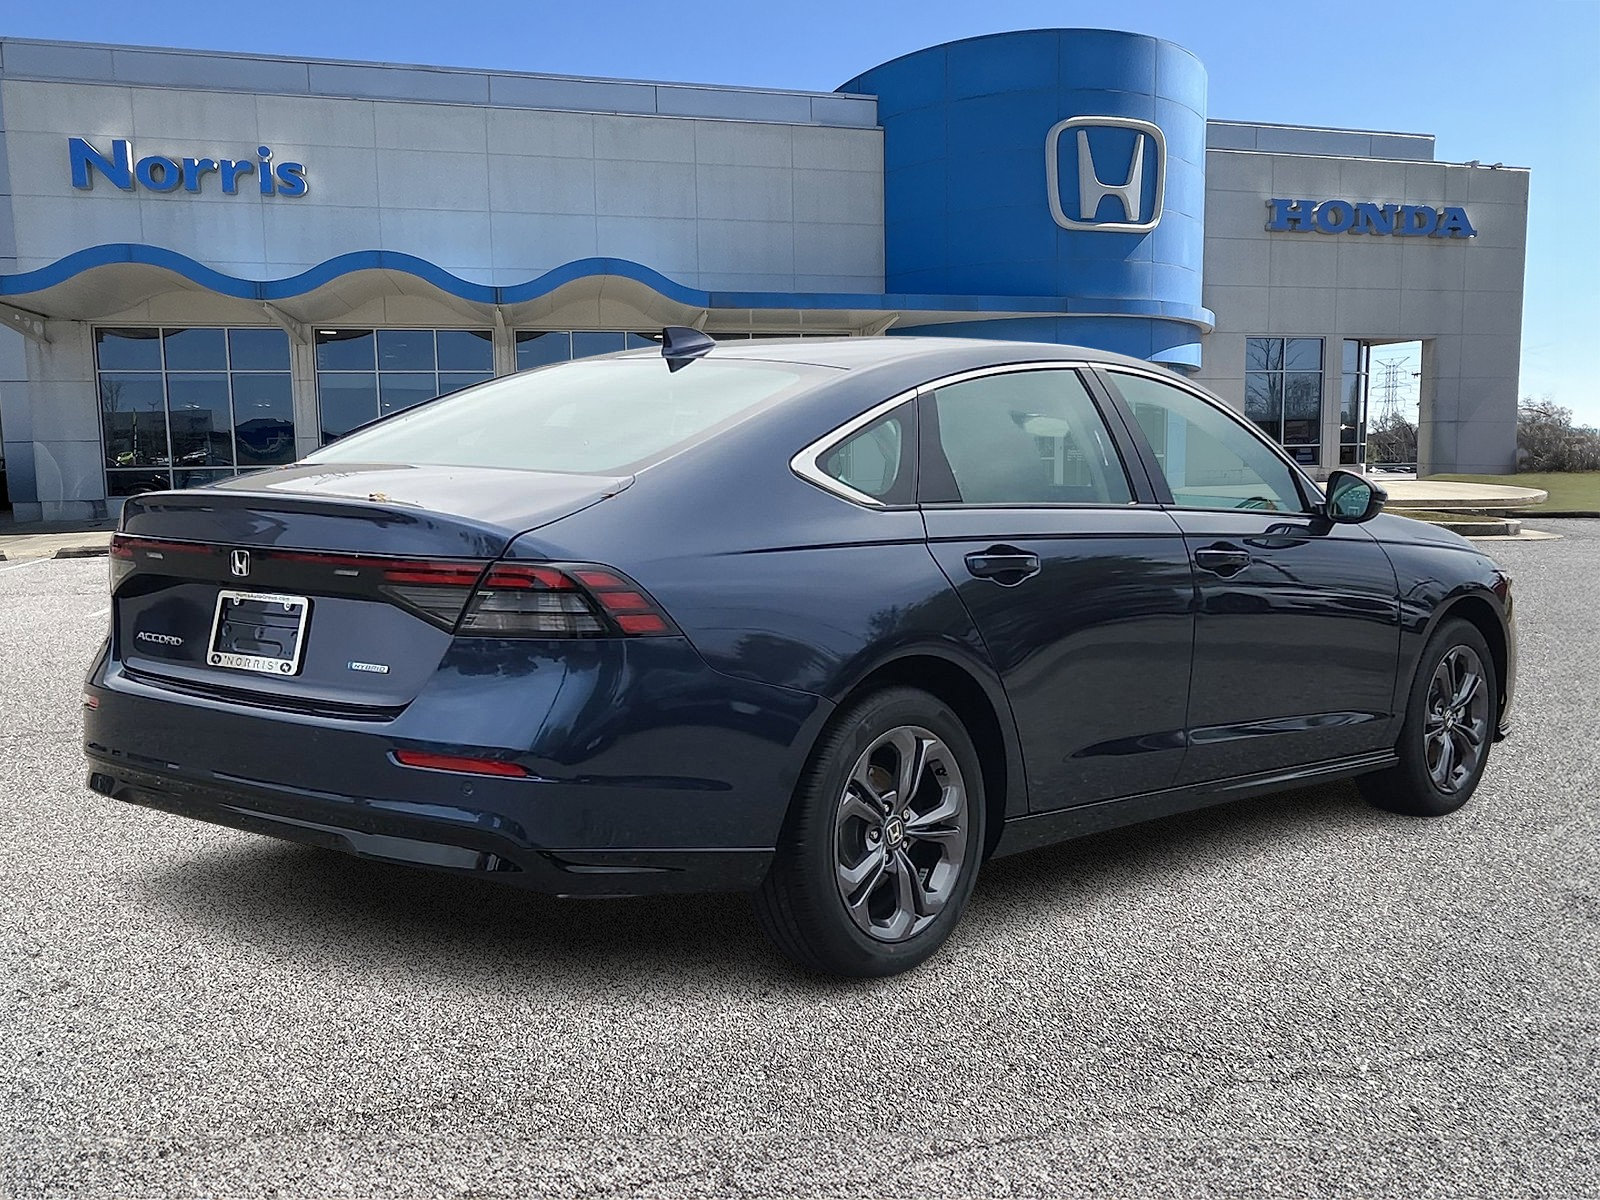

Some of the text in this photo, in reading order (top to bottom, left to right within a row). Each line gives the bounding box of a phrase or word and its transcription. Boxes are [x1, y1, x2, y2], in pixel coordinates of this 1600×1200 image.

[68, 137, 308, 197] Norris
[1265, 198, 1478, 238] HONDA
[136, 631, 182, 646] ACCORD
[353, 663, 386, 672] HYBRID
